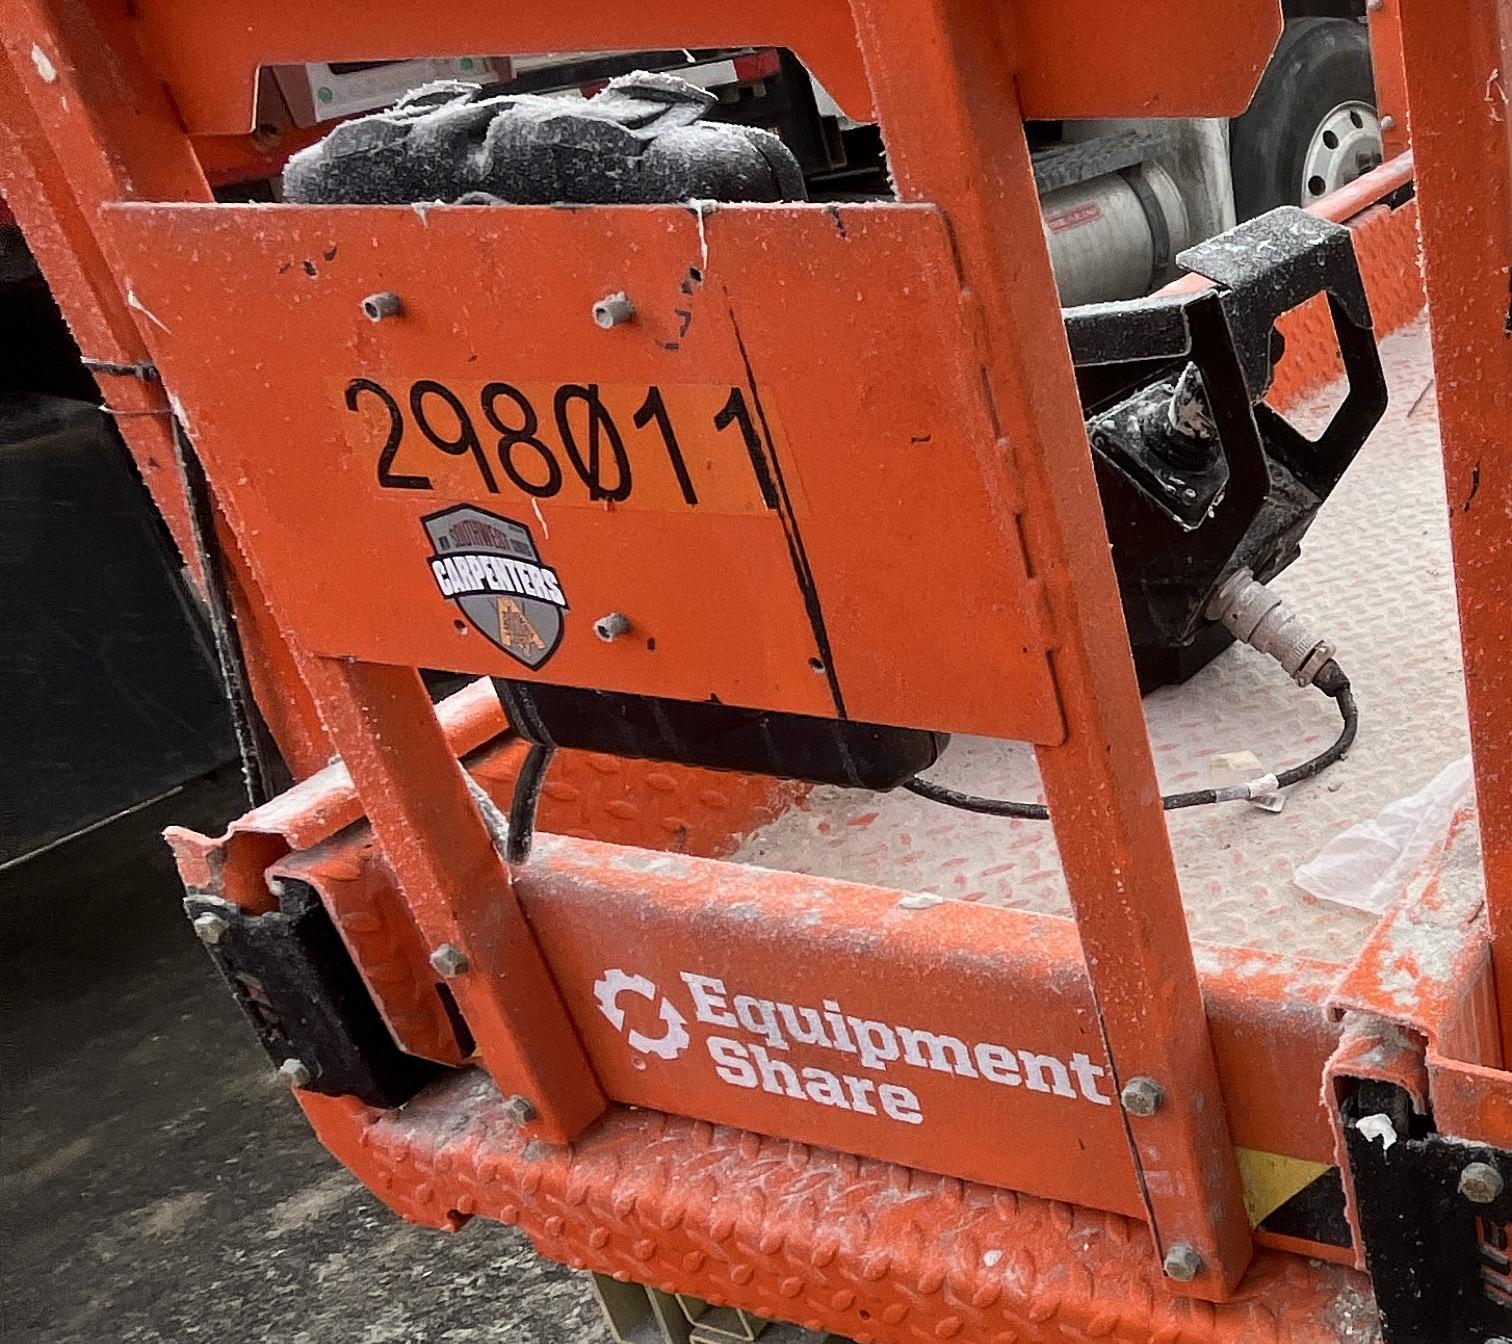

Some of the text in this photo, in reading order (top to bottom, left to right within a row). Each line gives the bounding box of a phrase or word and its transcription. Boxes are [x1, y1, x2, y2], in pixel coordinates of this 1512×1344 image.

[344, 377, 779, 511] 298011
[431, 554, 567, 606] CARPENTERS
[679, 970, 1112, 1106] Equipment
[706, 1036, 925, 1125] Share
